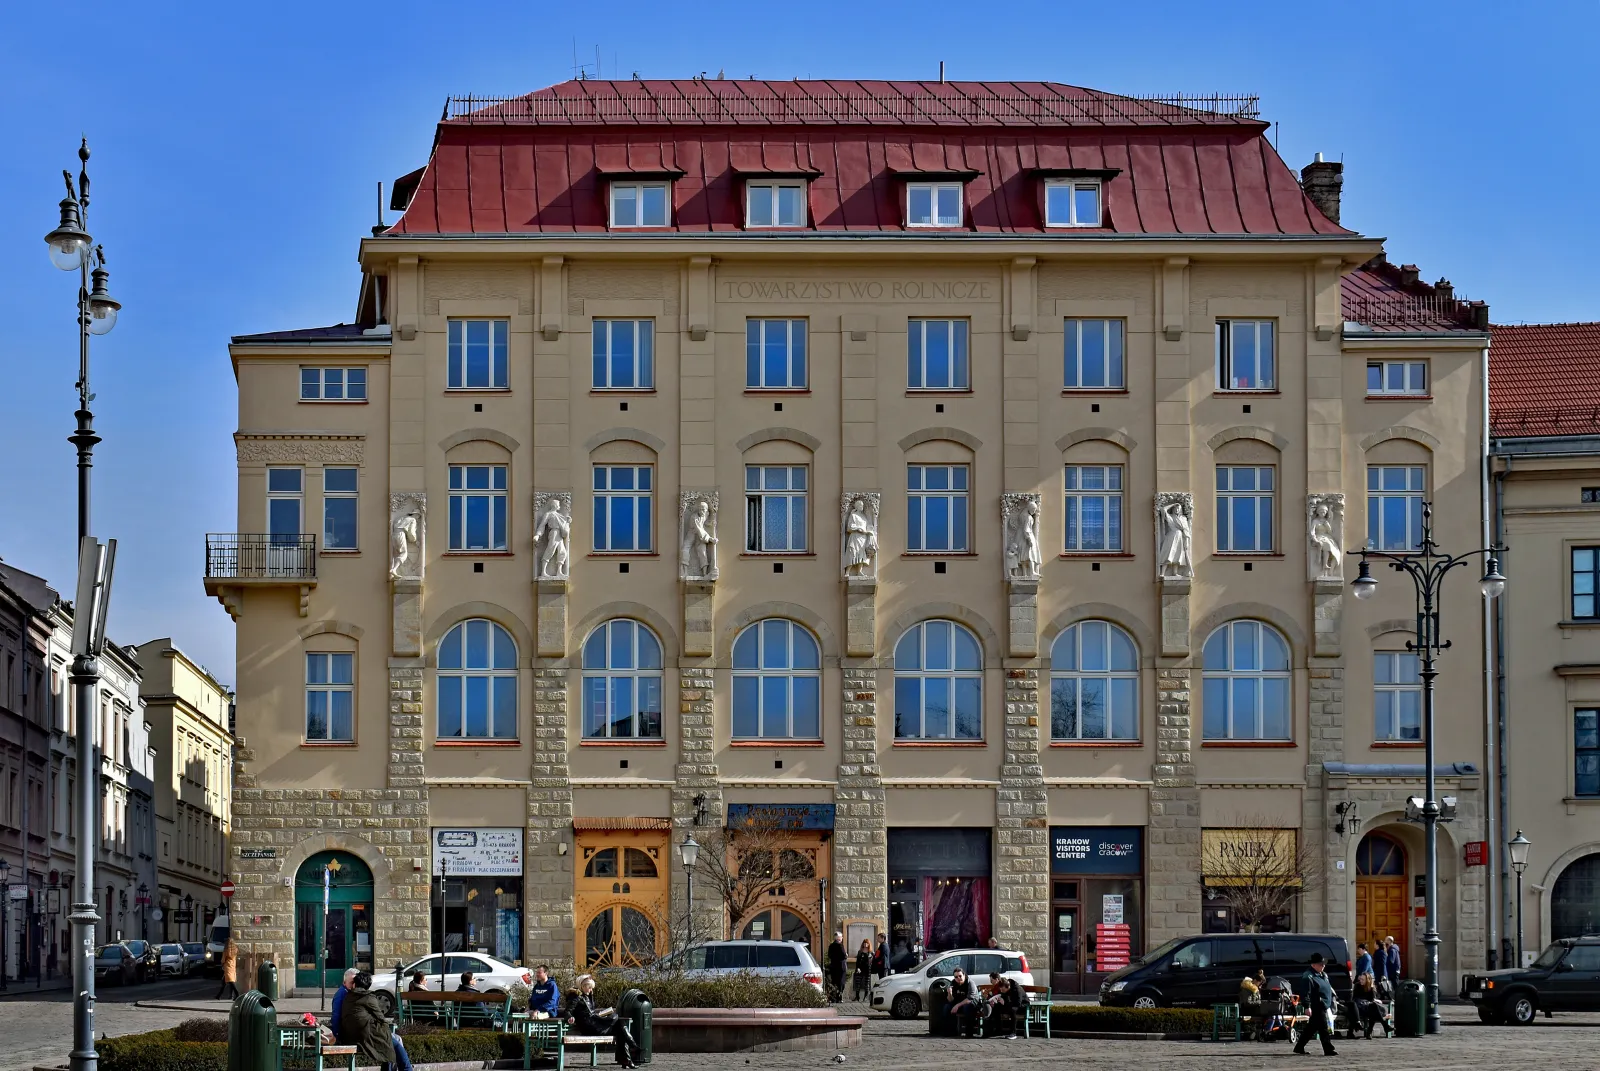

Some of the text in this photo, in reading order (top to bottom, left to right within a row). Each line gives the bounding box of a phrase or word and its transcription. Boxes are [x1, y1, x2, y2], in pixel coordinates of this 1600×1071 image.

[723, 280, 993, 300] TOWARZYSTWO ROLNICZE
[1098, 842, 1134, 851] discover
[1219, 841, 1277, 858] PASIEKA
